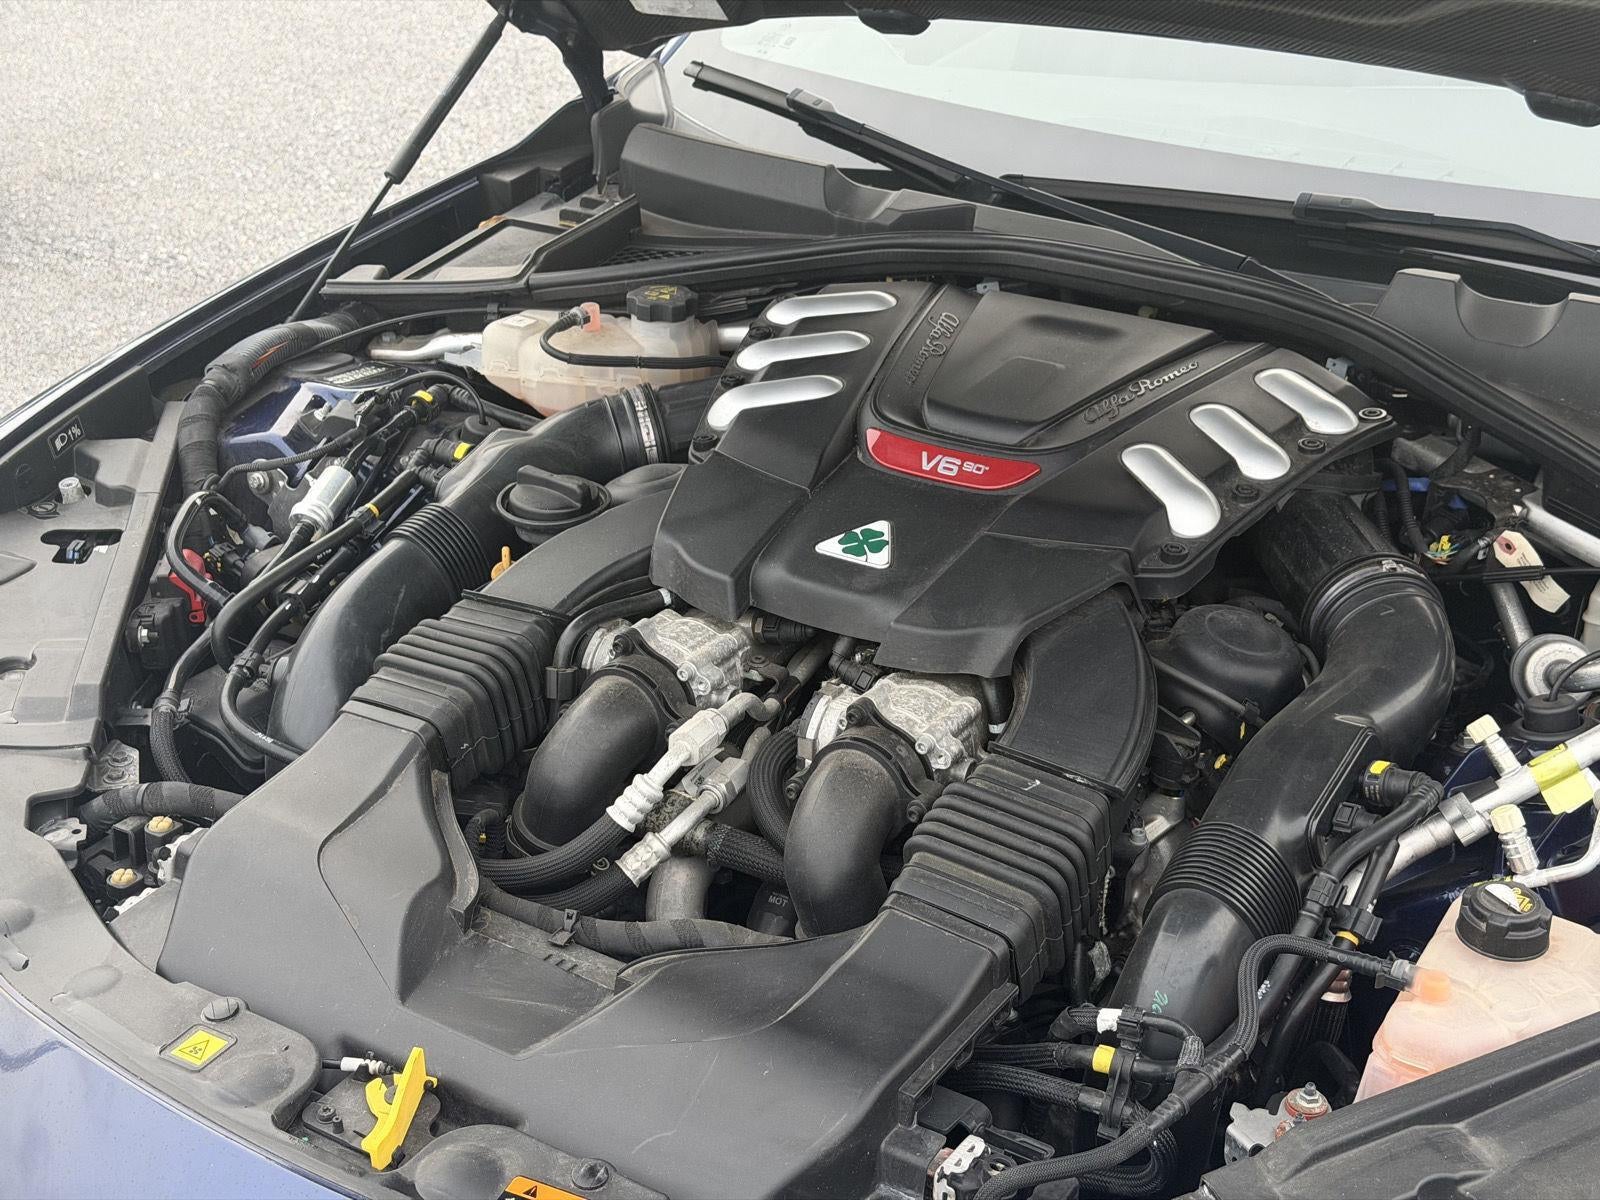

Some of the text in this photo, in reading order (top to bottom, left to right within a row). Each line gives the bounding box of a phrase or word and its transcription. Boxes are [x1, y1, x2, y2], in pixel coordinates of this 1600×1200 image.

[928, 312, 960, 340] Alfa
[1083, 361, 1199, 422] Alfa Romeo
[68, 423, 82, 441] 1%
[921, 451, 962, 476] V6
